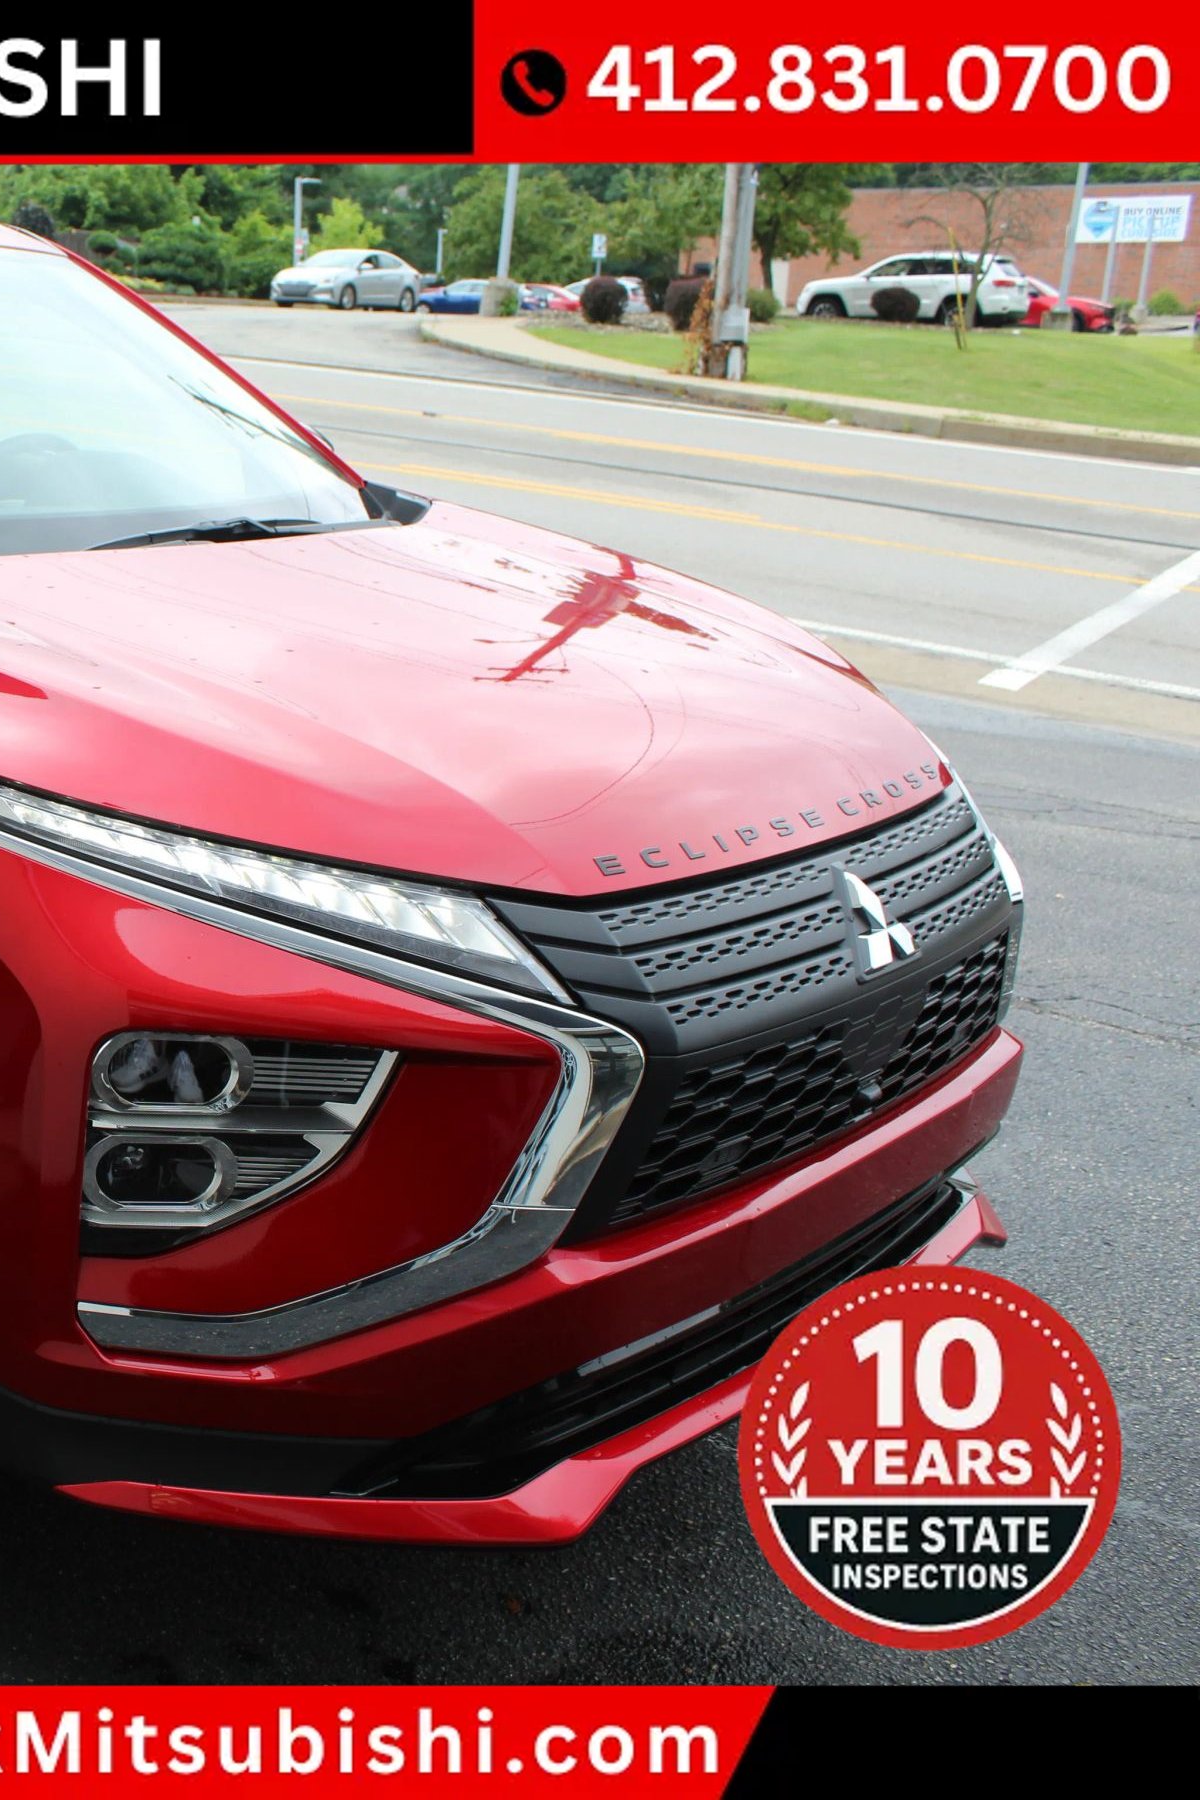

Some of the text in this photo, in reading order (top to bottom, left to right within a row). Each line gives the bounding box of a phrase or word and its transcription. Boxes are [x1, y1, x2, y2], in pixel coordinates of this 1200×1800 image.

[1123, 206, 1183, 216] BUY ONLINE
[593, 760, 938, 877] ECLIPSE CROSS
